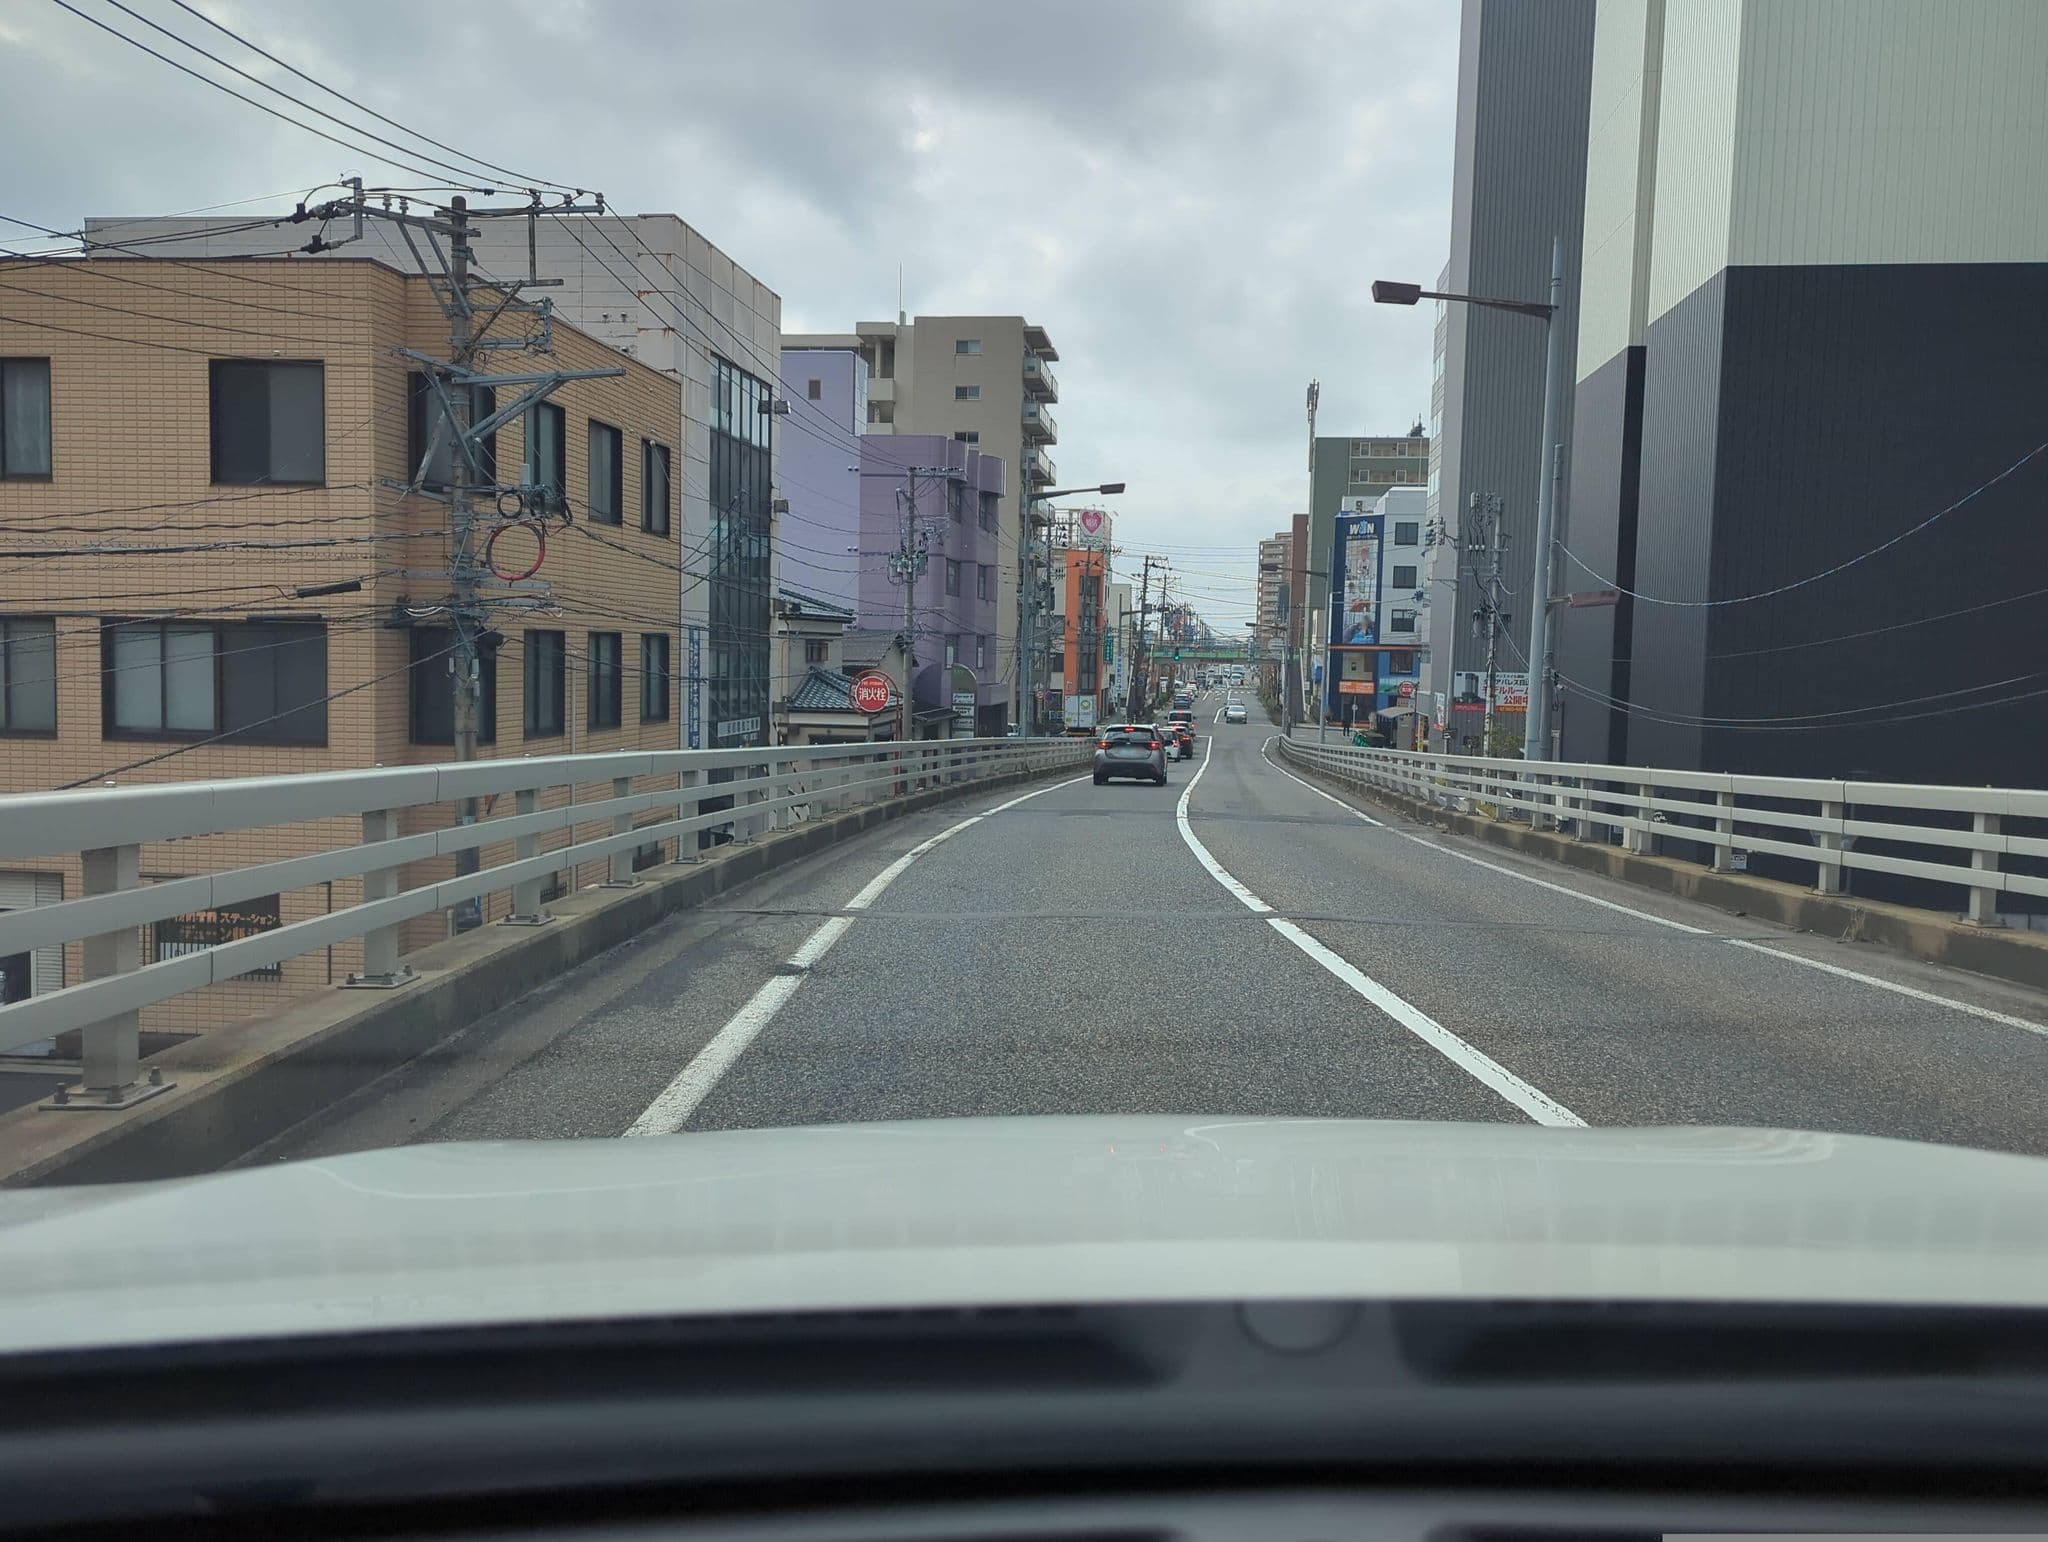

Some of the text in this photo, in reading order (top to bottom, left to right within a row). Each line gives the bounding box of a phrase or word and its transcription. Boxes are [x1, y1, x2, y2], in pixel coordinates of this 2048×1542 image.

[858, 687, 888, 701] 消火栓
[220, 912, 277, 925] ステーション
